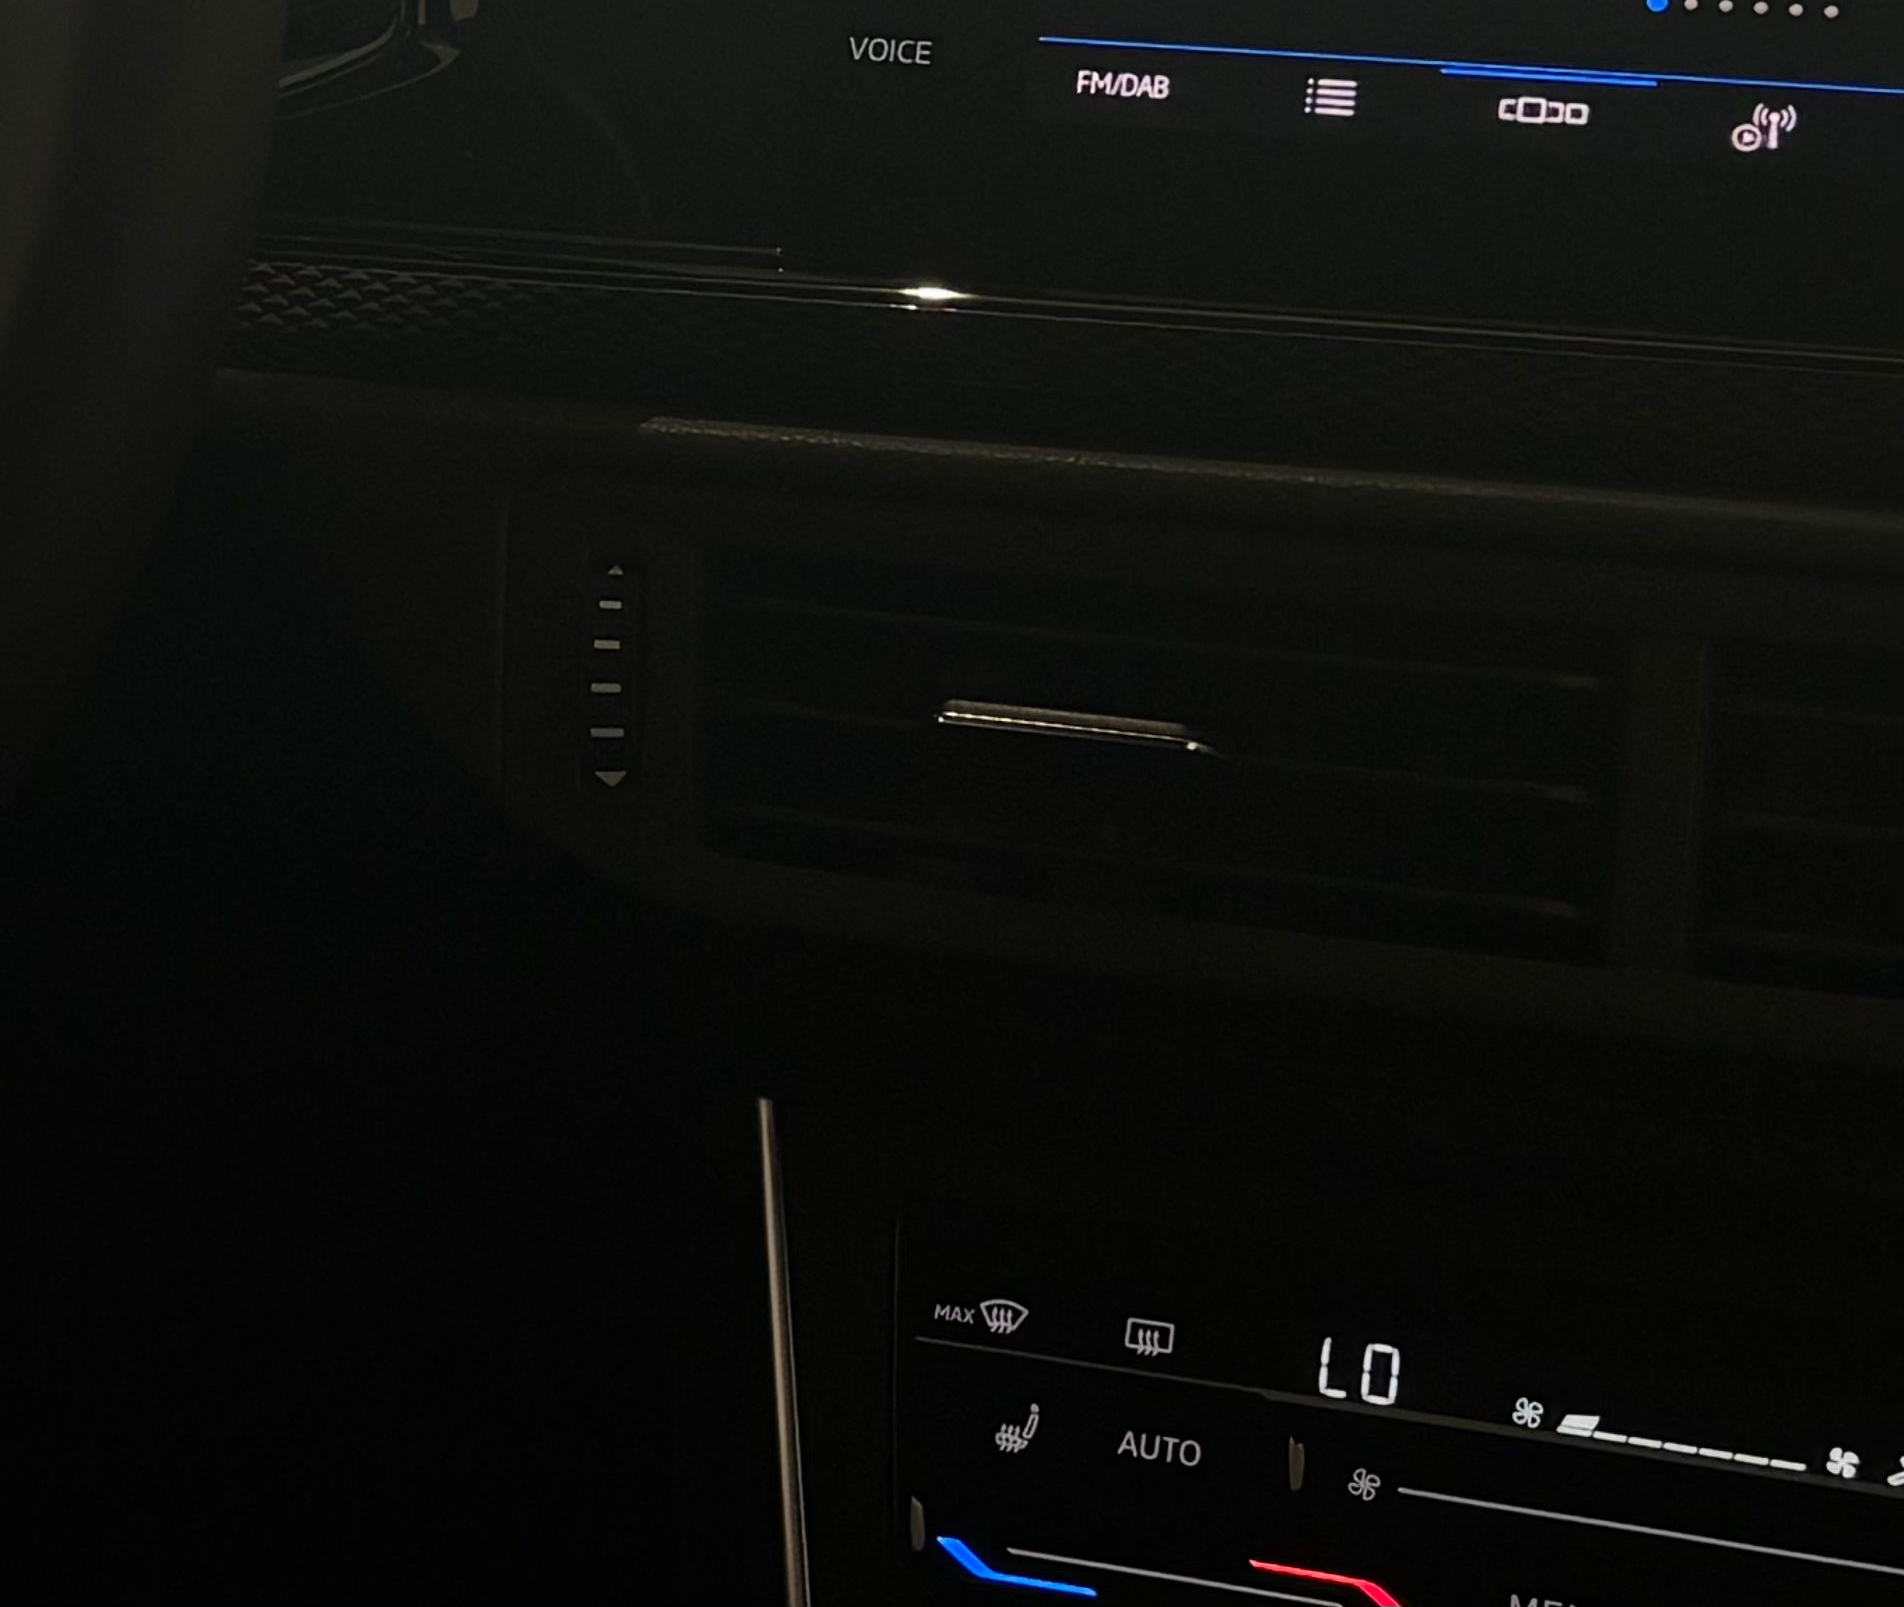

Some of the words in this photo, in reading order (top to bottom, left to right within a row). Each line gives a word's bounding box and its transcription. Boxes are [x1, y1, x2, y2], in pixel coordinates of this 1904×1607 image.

[849, 36, 933, 65] VOICE
[1076, 69, 1170, 100] FM/DAB
[934, 1303, 975, 1325] MAX
[1117, 1430, 1202, 1467] AUTO
